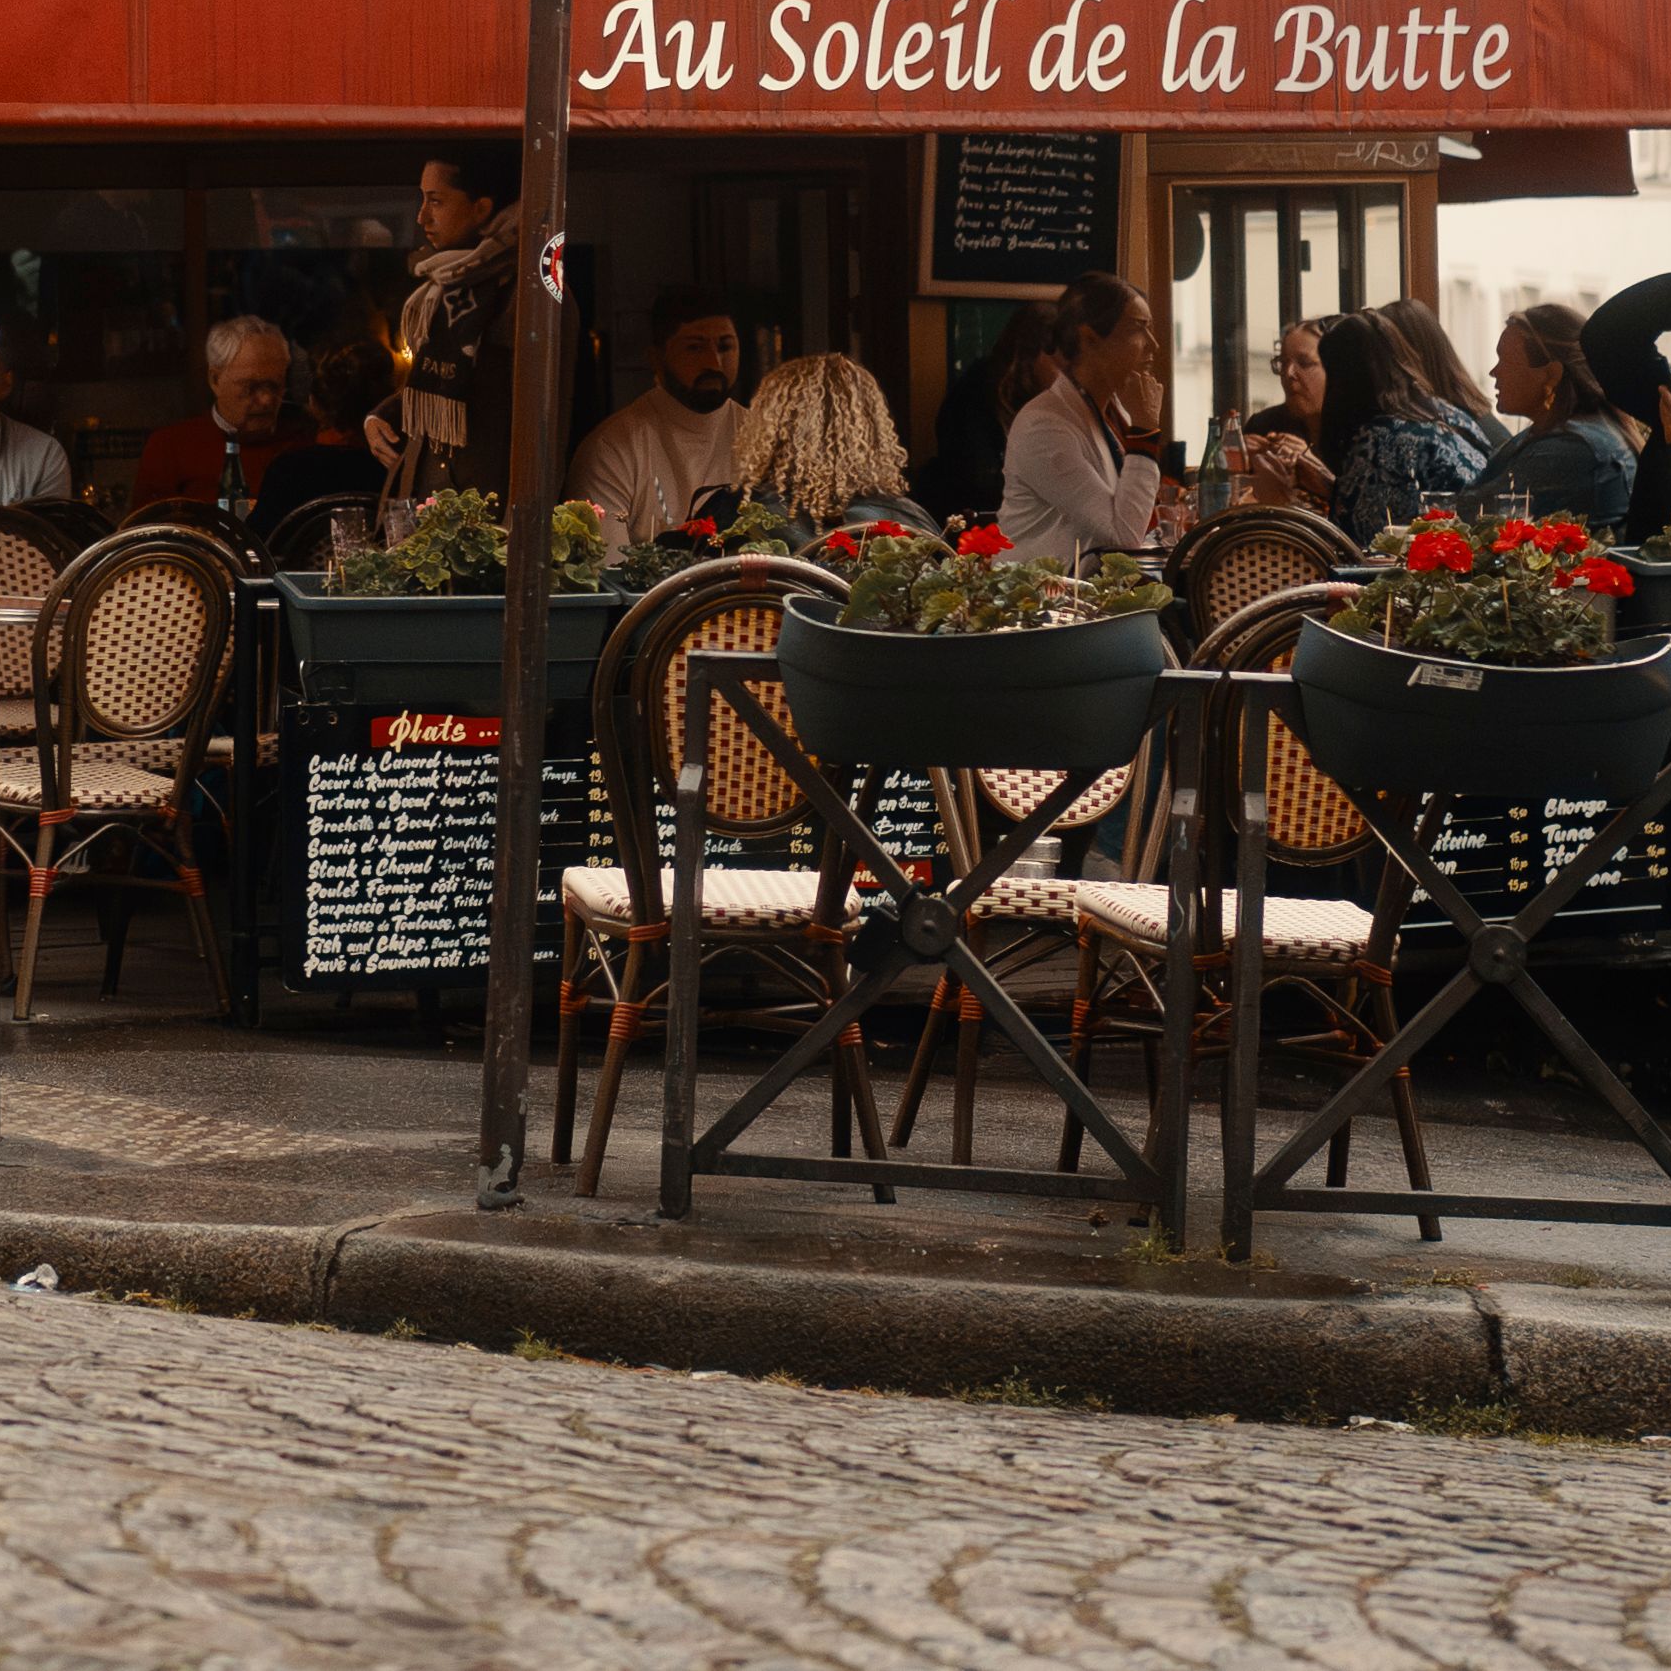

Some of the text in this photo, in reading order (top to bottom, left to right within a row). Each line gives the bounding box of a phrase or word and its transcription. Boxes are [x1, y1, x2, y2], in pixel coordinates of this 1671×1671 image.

[1270, 2, 1514, 95] Butte
[388, 709, 467, 753] Plats
[308, 753, 358, 776] Confit
[379, 750, 442, 773] Canard
[364, 769, 440, 792] Rumsteak
[306, 792, 371, 814] Tartare
[388, 790, 435, 812] Boeuf
[872, 815, 925, 837] Burger
[307, 837, 357, 859] Souris
[308, 857, 359, 880] Steak
[376, 854, 435, 877] Cheval
[306, 880, 360, 902] Poulet
[366, 878, 425, 898] Fermier
[306, 897, 385, 920] Carpaccio
[307, 918, 375, 936] Saucisse
[306, 934, 342, 955] Fish
[303, 953, 347, 978] Pavé
[365, 953, 431, 975] Saumon
